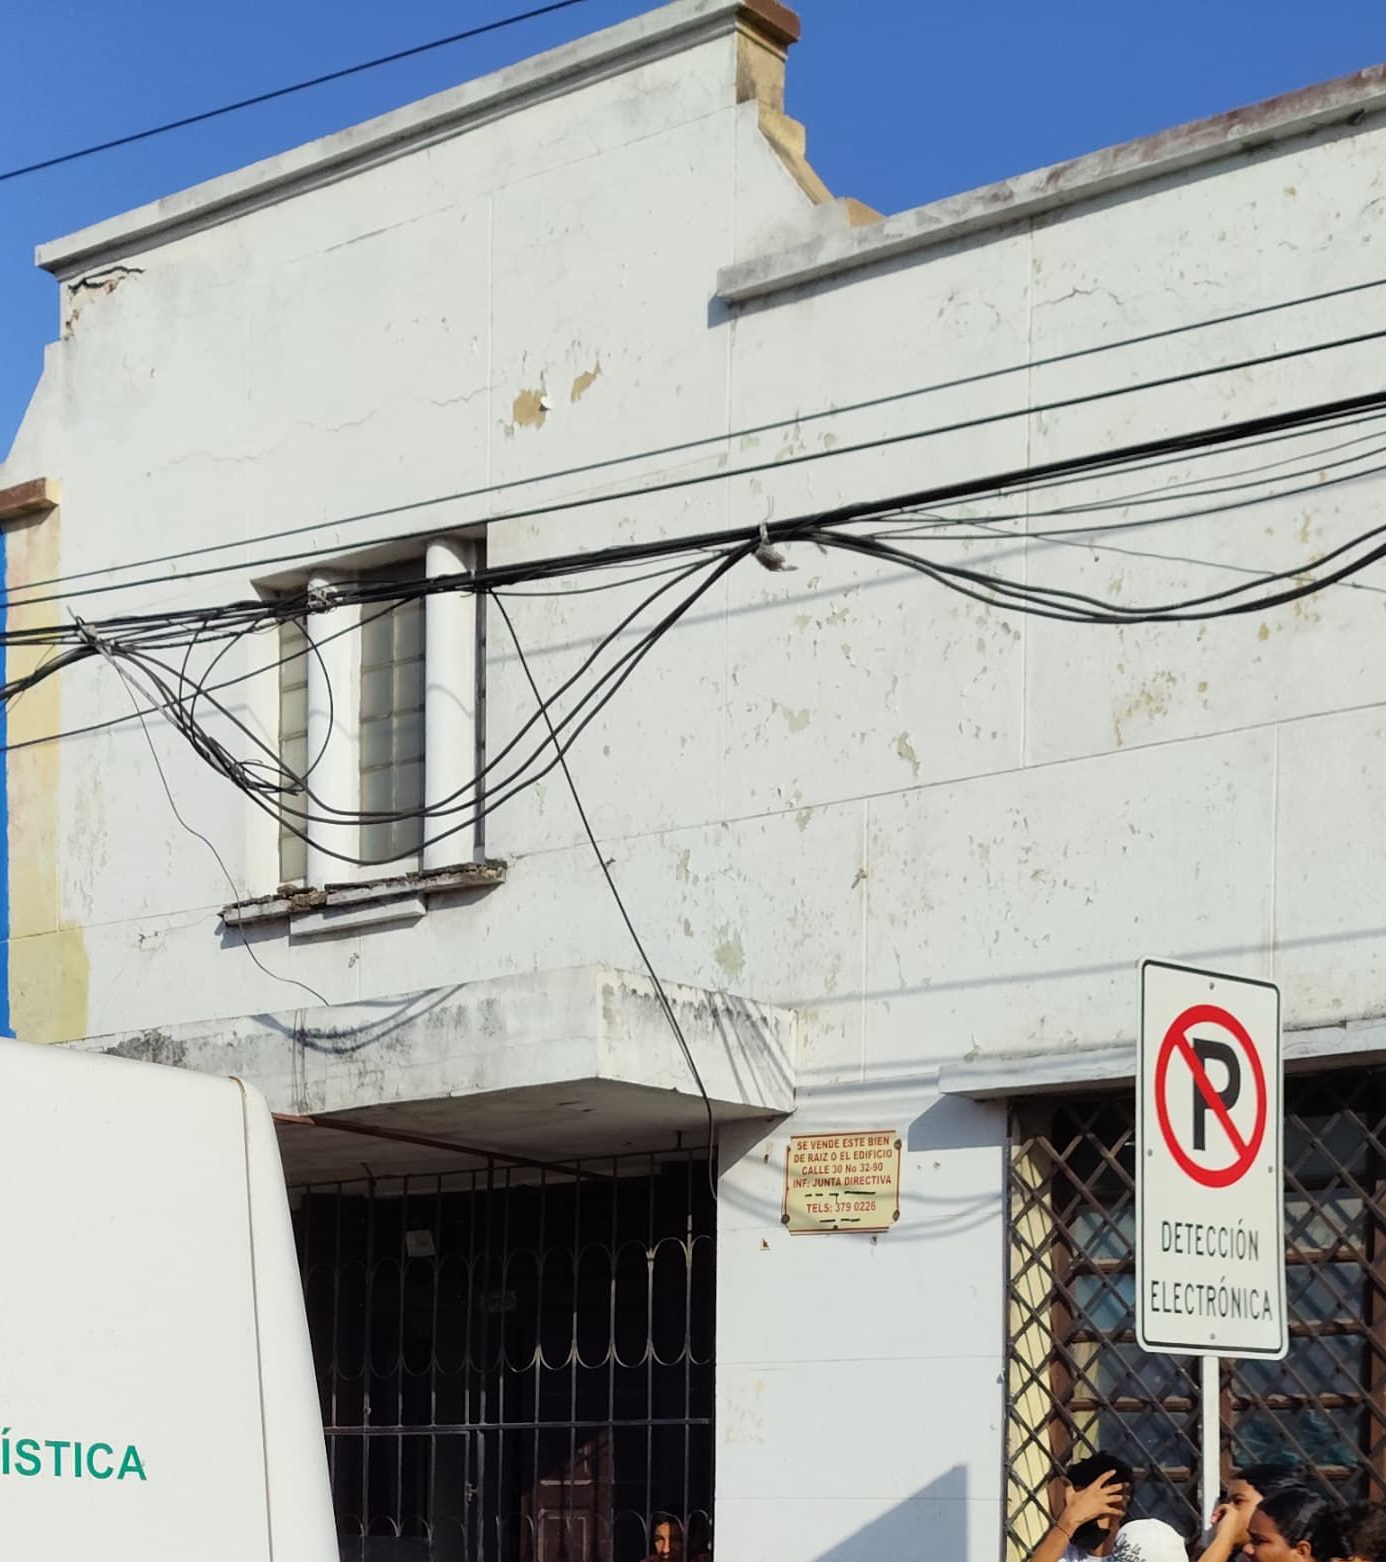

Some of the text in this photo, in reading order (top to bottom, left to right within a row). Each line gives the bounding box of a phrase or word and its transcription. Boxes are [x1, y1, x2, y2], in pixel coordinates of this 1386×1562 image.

[1192, 1037, 1241, 1151] P
[797, 1136, 890, 1151] SE VENDE ESTE BIEN
[793, 1149, 892, 1163] DE RAIZ O EL EDIFICIO
[802, 1165, 830, 1175] CALLE
[832, 1164, 843, 1174] 30
[793, 1175, 892, 1188] INF: JUNTA DIRECTIVA
[806, 1201, 876, 1213] TELS: 379 0226
[1162, 1218, 1259, 1262] DETECCIÓN
[1151, 1276, 1273, 1321] ELECTRÓNICA
